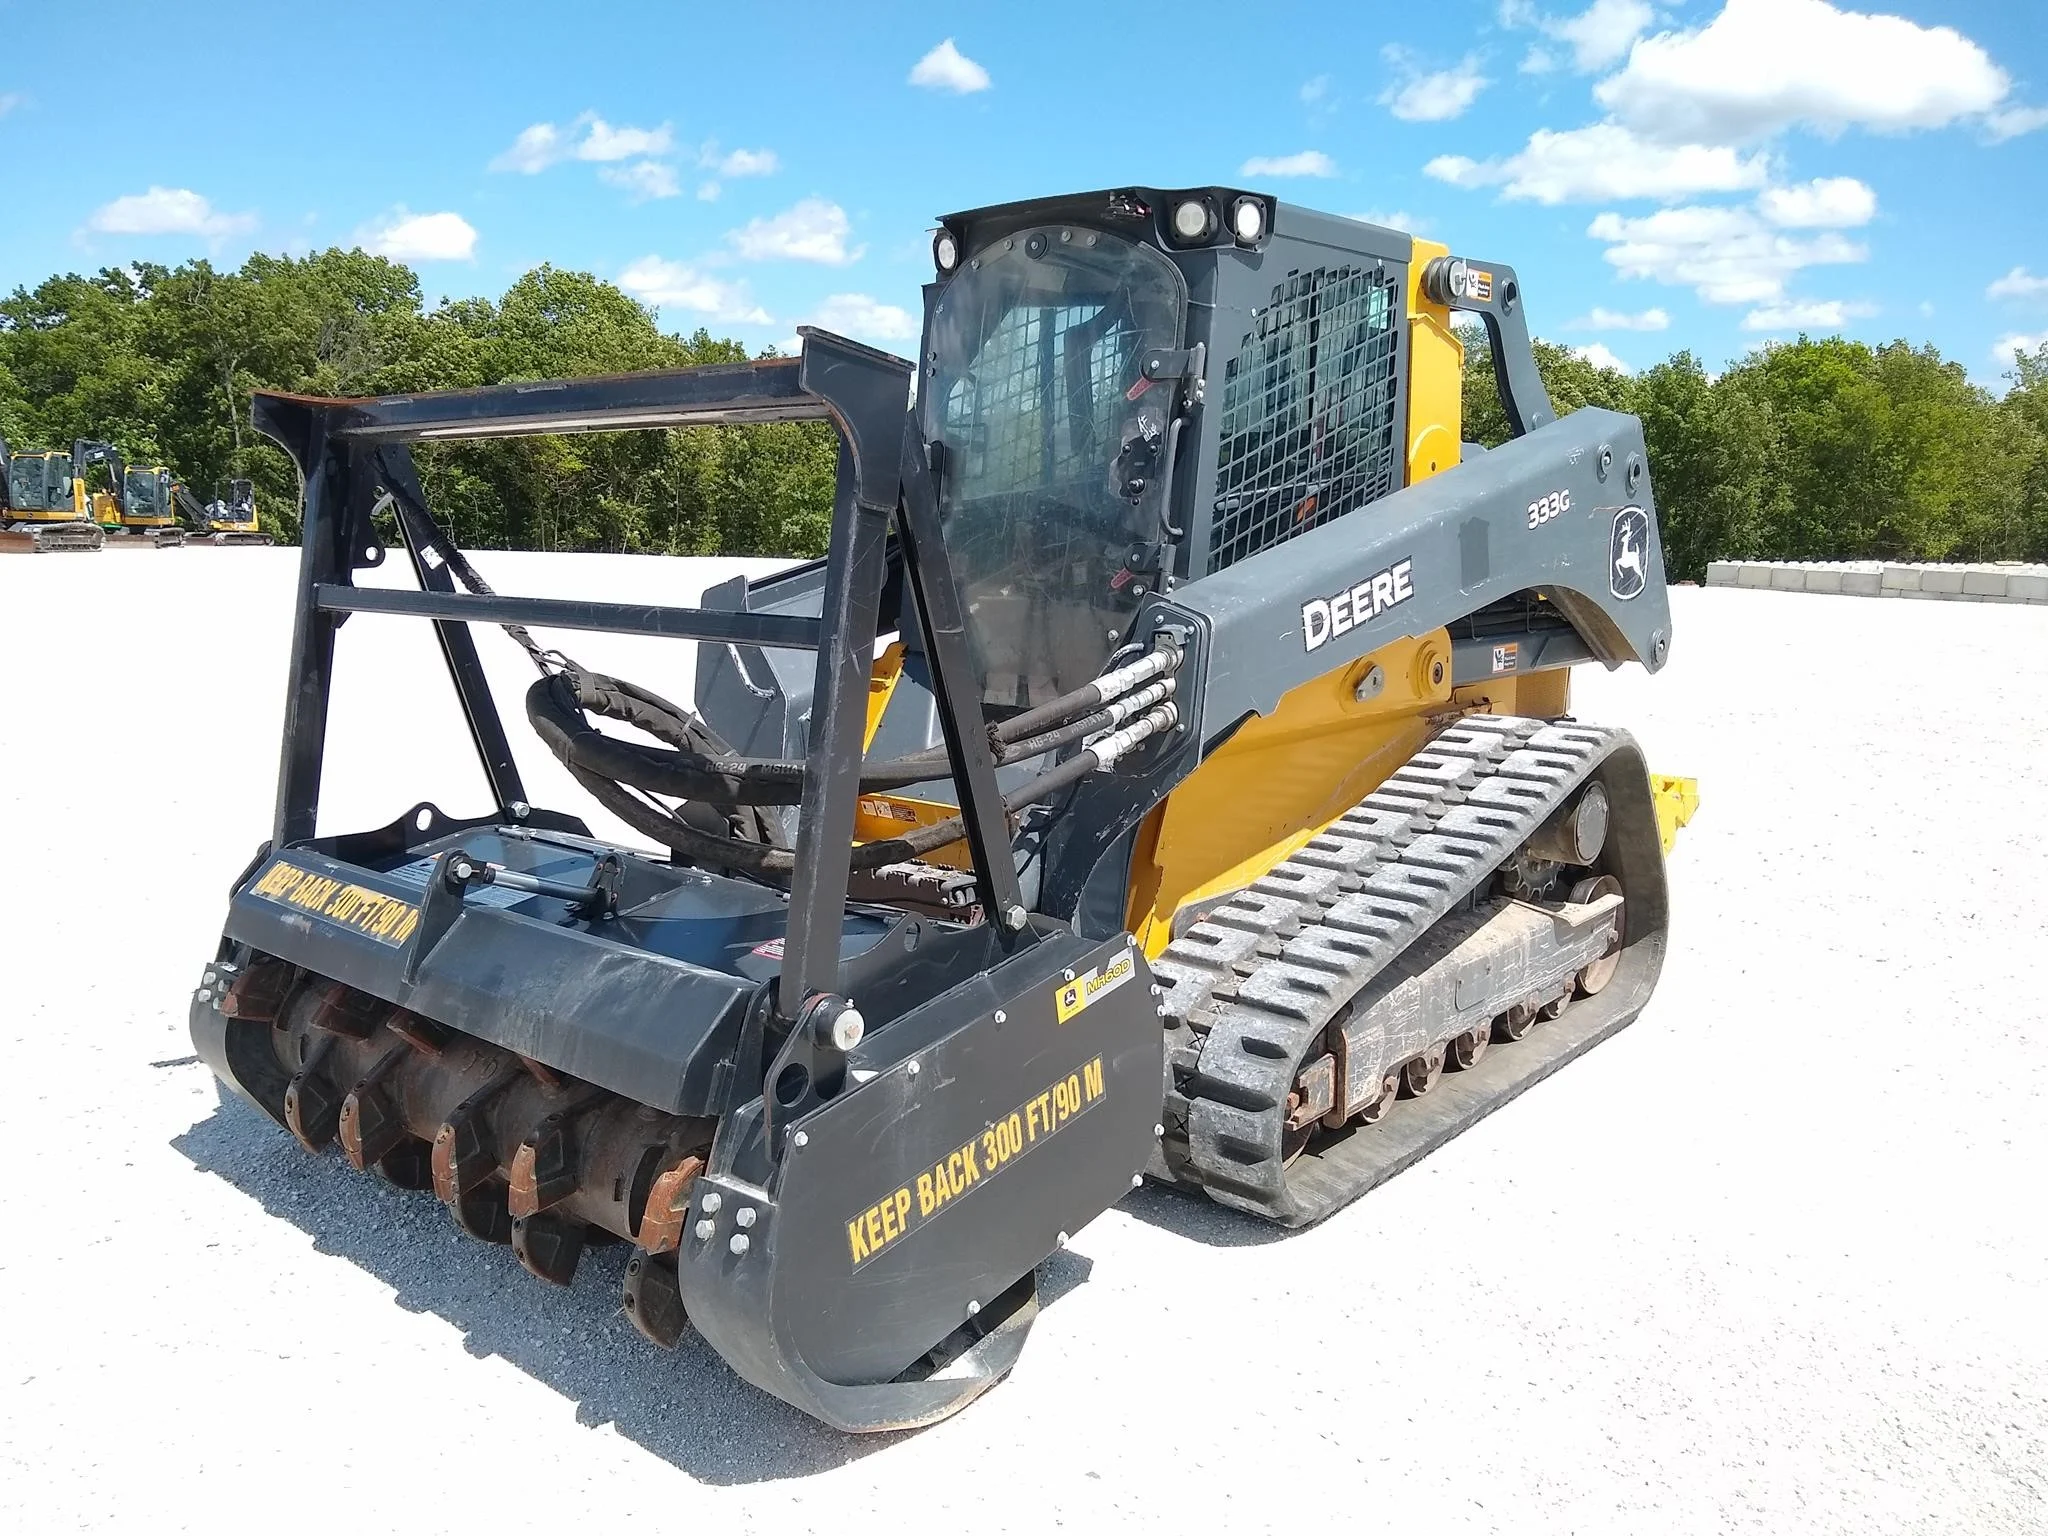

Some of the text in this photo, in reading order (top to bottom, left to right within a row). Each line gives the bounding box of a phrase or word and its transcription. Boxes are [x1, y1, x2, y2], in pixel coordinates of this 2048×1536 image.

[1527, 488, 1570, 530] 333G
[1302, 559, 1413, 652] DEERE
[289, 873, 342, 911] BACK
[324, 884, 362, 921] 300
[391, 909, 419, 941] M
[1086, 958, 1131, 995] MH60D
[849, 1058, 1104, 1264] KEEP BACK 300 FT/90 M
